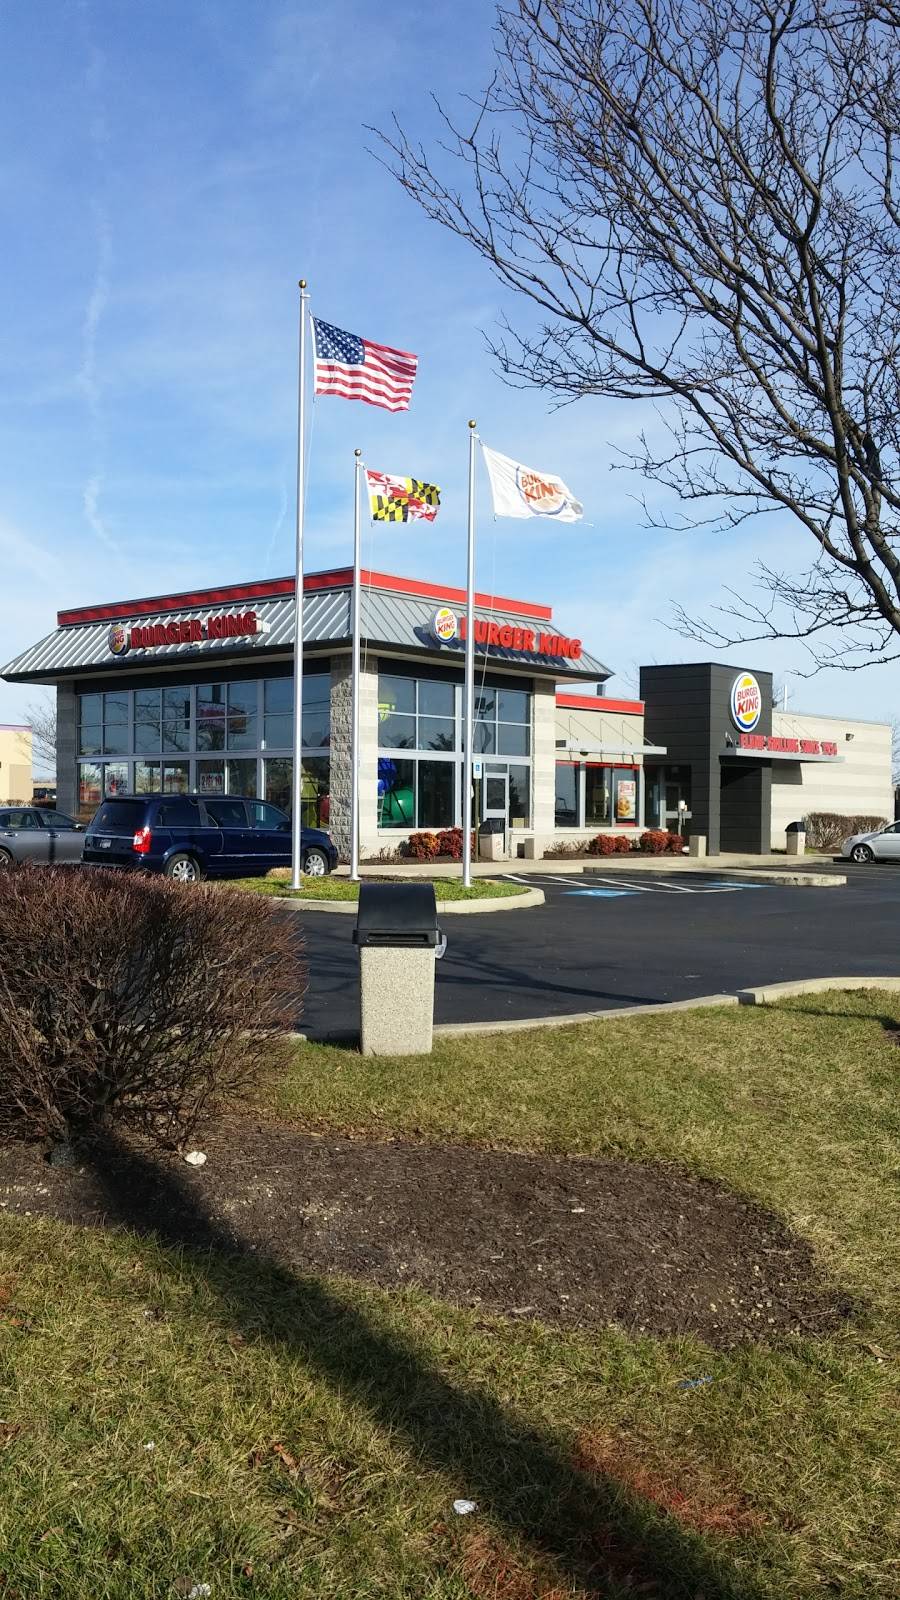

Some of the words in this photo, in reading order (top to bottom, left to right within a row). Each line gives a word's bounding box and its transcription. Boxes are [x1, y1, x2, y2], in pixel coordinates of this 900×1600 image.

[130, 619, 203, 649] BURGER
[207, 611, 257, 640] KING
[436, 620, 456, 634] KING
[538, 632, 582, 660] KING
[737, 686, 758, 701] BURGER
[736, 697, 759, 716] KING
